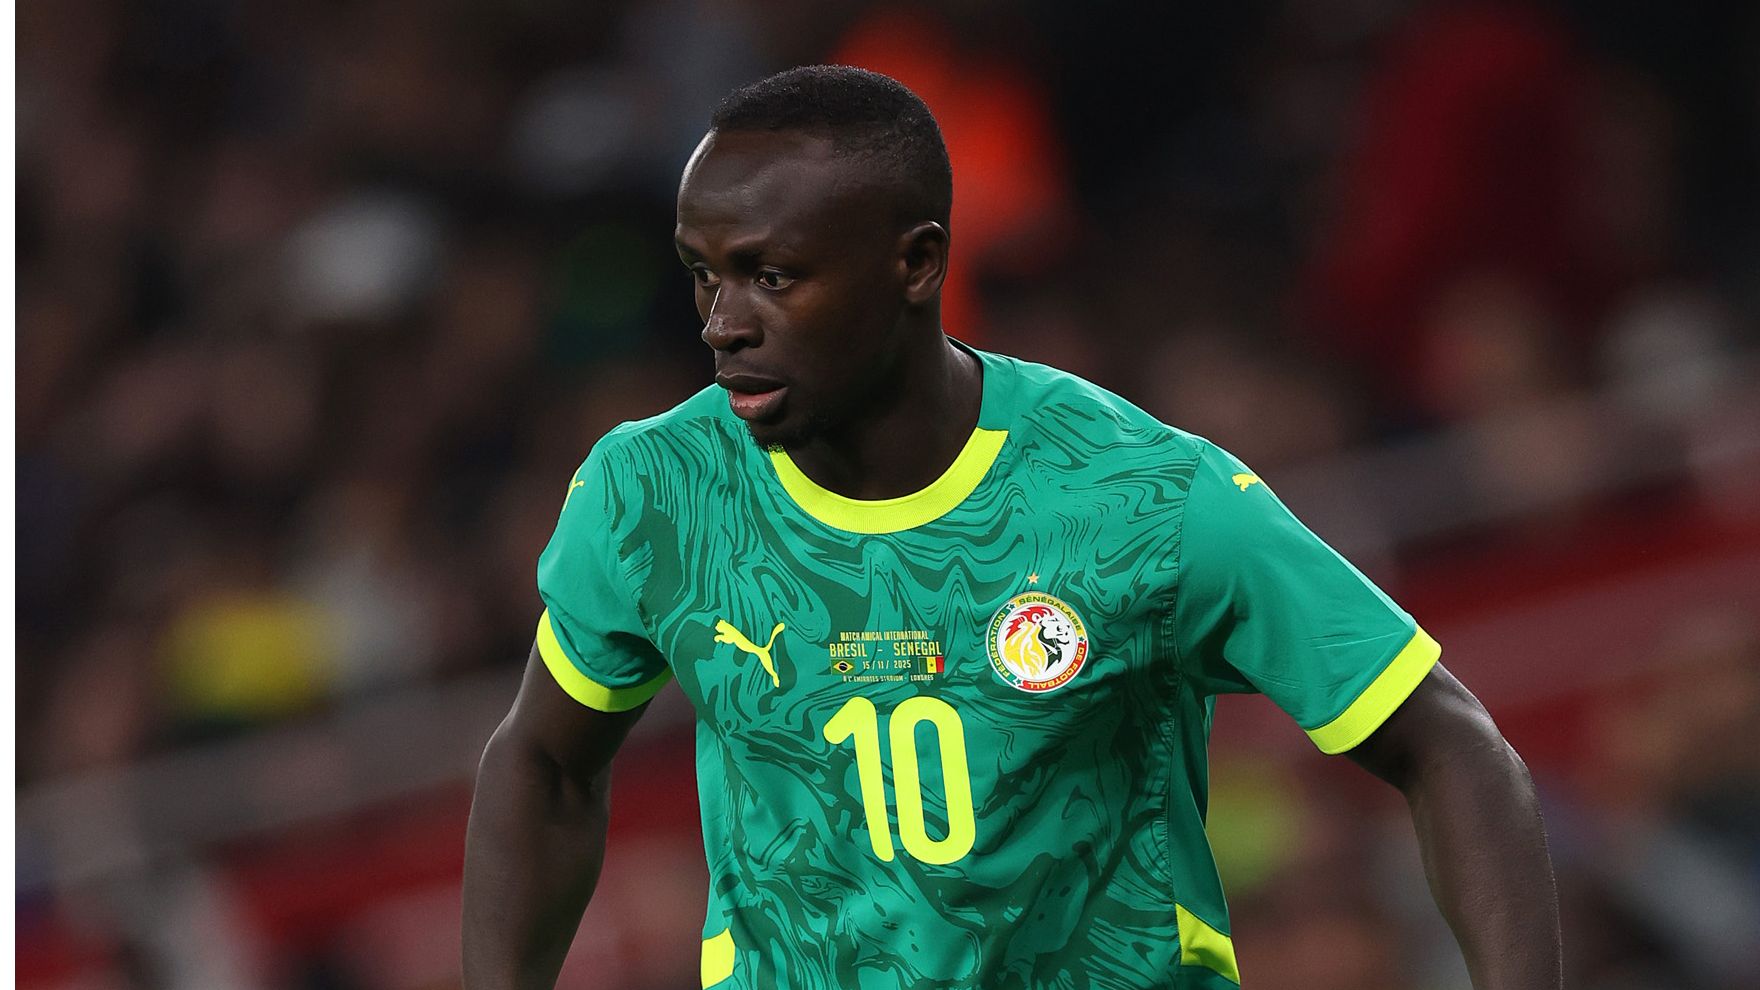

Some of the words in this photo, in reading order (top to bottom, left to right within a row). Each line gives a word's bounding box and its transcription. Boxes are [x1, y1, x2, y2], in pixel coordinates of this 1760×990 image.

[1018, 595, 1082, 631] SÉNÉGALAISE
[840, 631, 860, 642] MATCH
[861, 631, 883, 641] AMICAL
[884, 630, 929, 641] INTERNATIONAL
[990, 612, 1010, 678] FÉDÉRATION
[829, 643, 868, 657] BRESIL
[893, 641, 942, 656] SENEGAL
[1075, 647, 1085, 660] DE
[910, 673, 934, 682] LONDRES
[1028, 663, 1078, 689] FOOTBALL
[823, 696, 976, 865] 10
